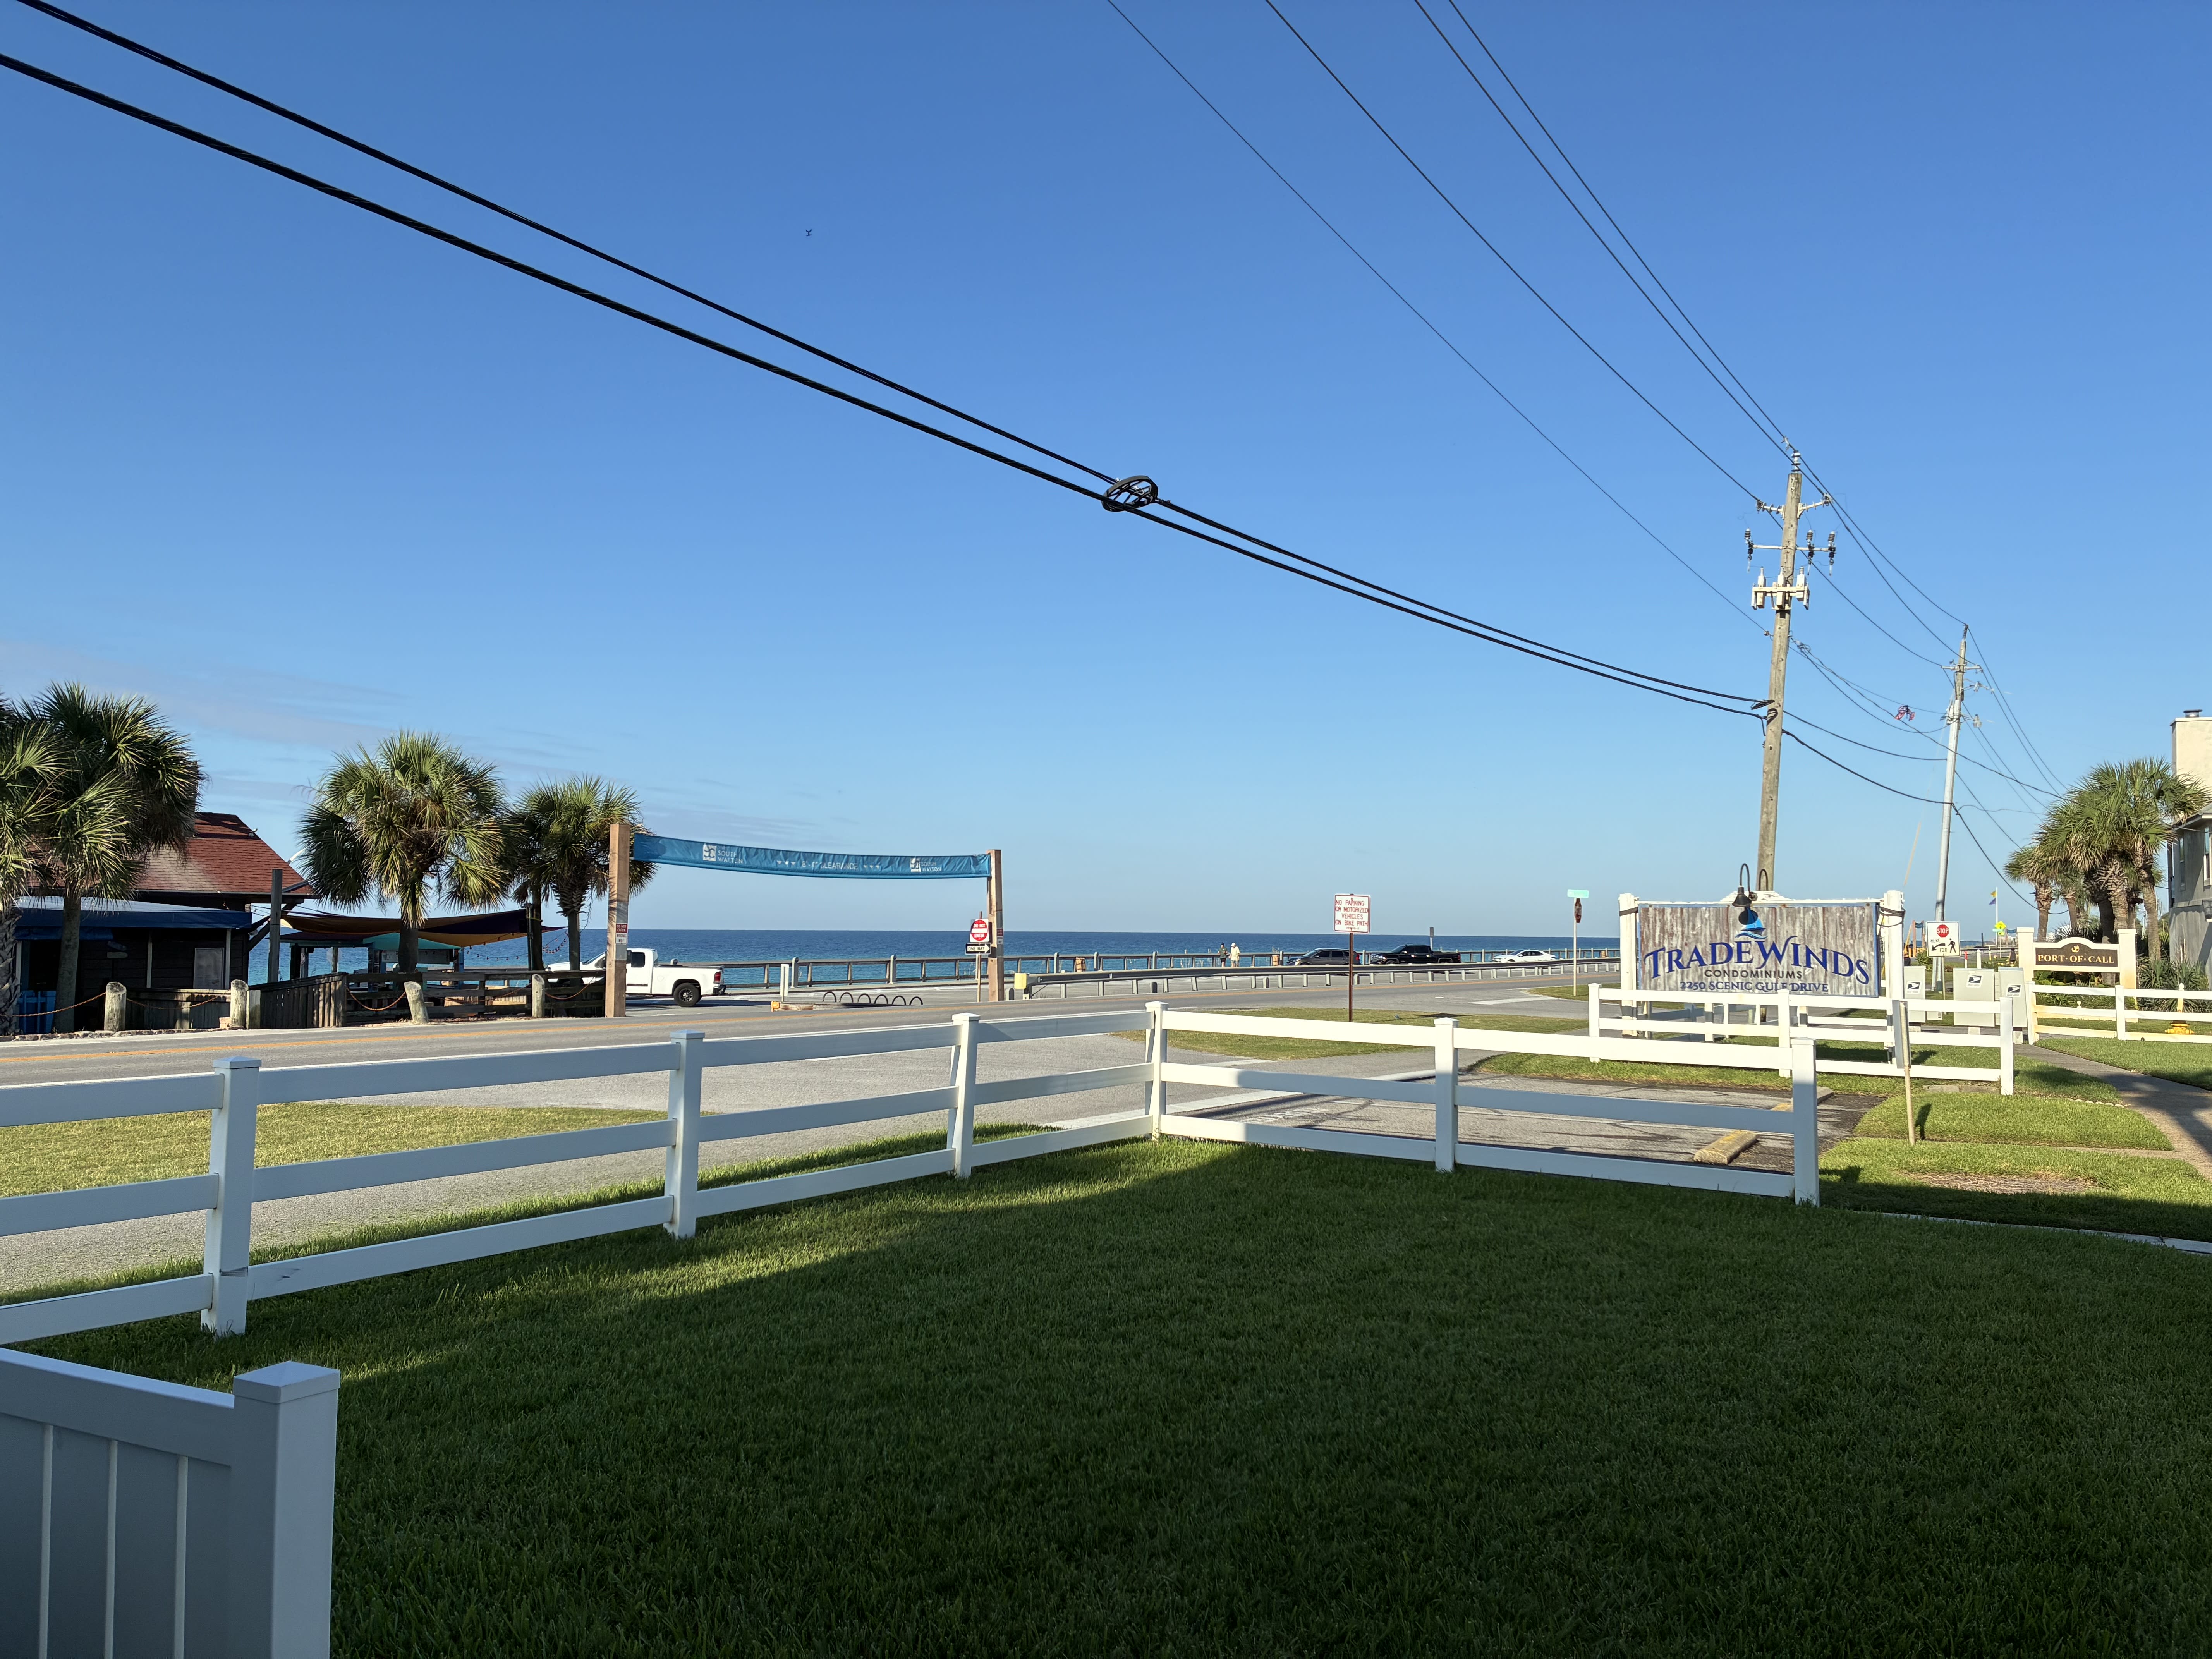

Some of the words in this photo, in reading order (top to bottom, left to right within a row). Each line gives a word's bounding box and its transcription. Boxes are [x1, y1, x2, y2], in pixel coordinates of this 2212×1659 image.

[1704, 969, 1802, 979] CONDOMINIUMS
[1680, 981, 1706, 990] 2250
[1709, 981, 1753, 991] SCENIC
[1755, 982, 1788, 992] GULF
[1789, 982, 1828, 992] DRIVE
